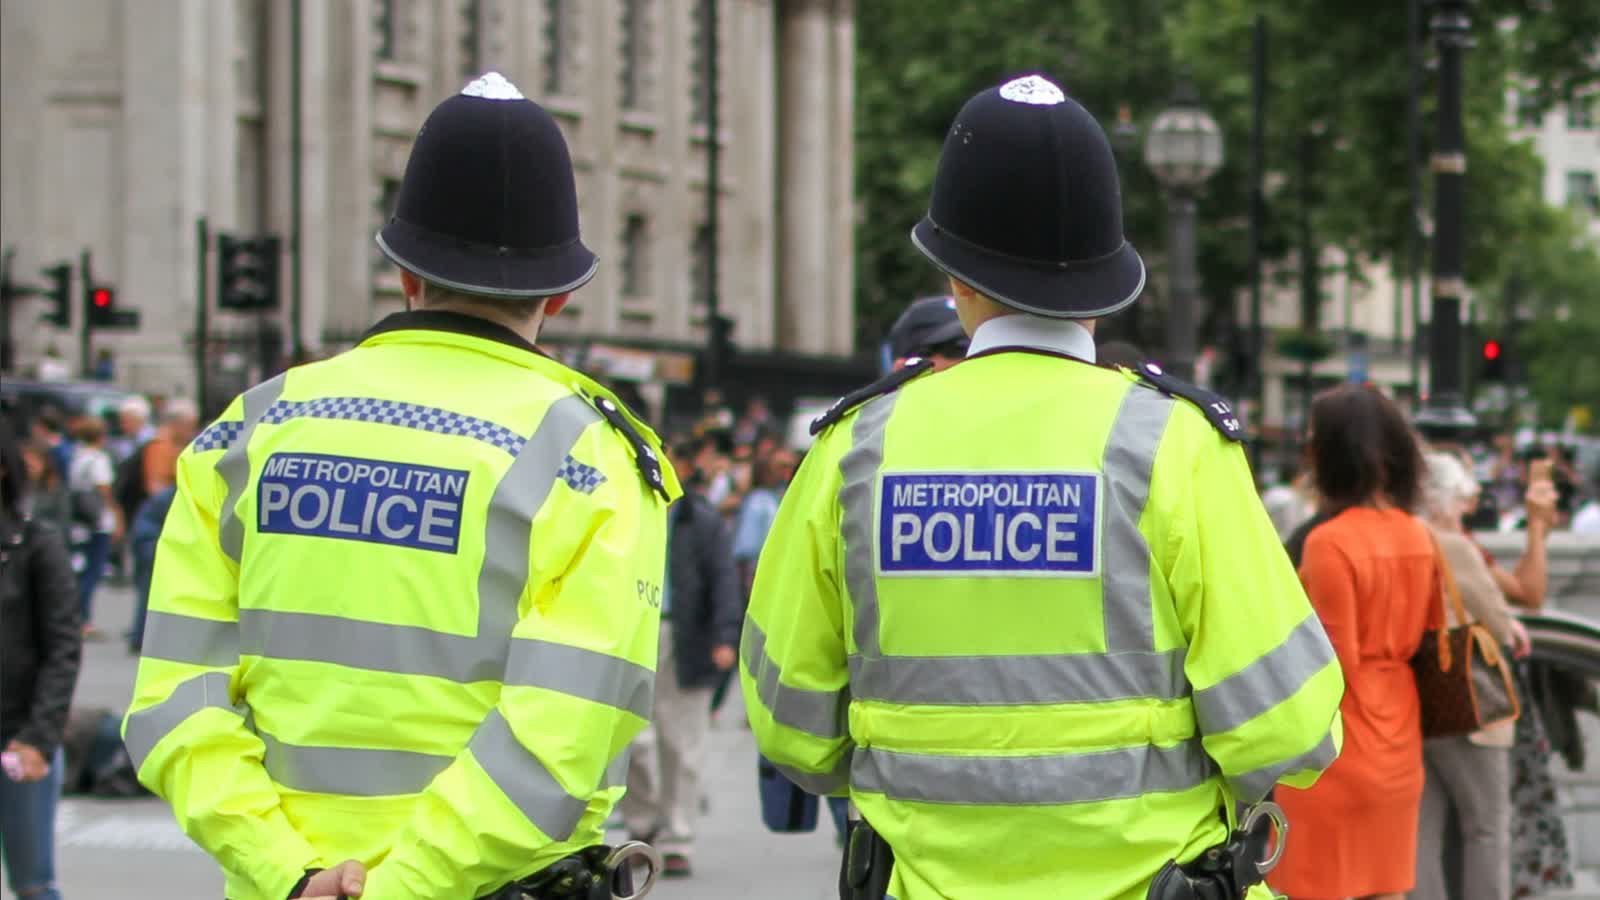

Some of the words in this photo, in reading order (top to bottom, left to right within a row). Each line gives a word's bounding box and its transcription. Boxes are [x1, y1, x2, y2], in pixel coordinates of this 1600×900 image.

[264, 457, 465, 497] METROPOLITAN
[893, 483, 1081, 507] METROPOLITAN
[260, 482, 458, 546] POLICE
[891, 512, 1079, 562] POLICE
